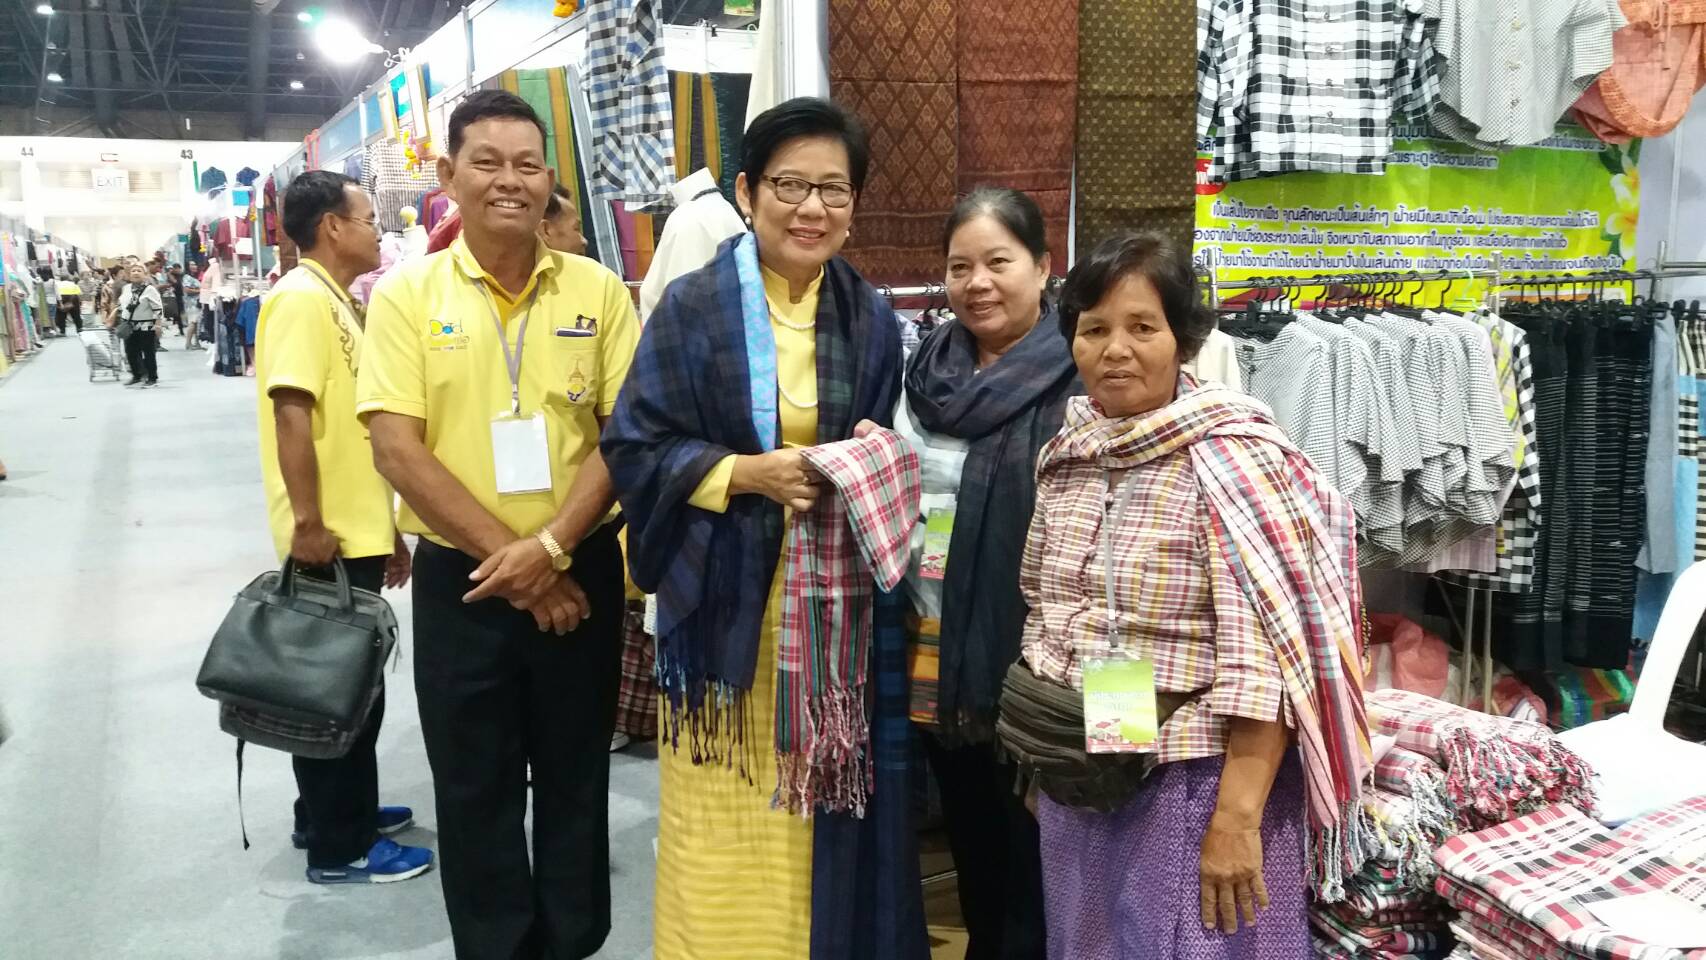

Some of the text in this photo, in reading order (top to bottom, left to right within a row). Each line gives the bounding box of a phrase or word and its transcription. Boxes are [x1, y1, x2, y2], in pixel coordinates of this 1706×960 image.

[20, 147, 35, 157] 44
[179, 149, 194, 160] 43
[96, 175, 125, 187] EXIT
